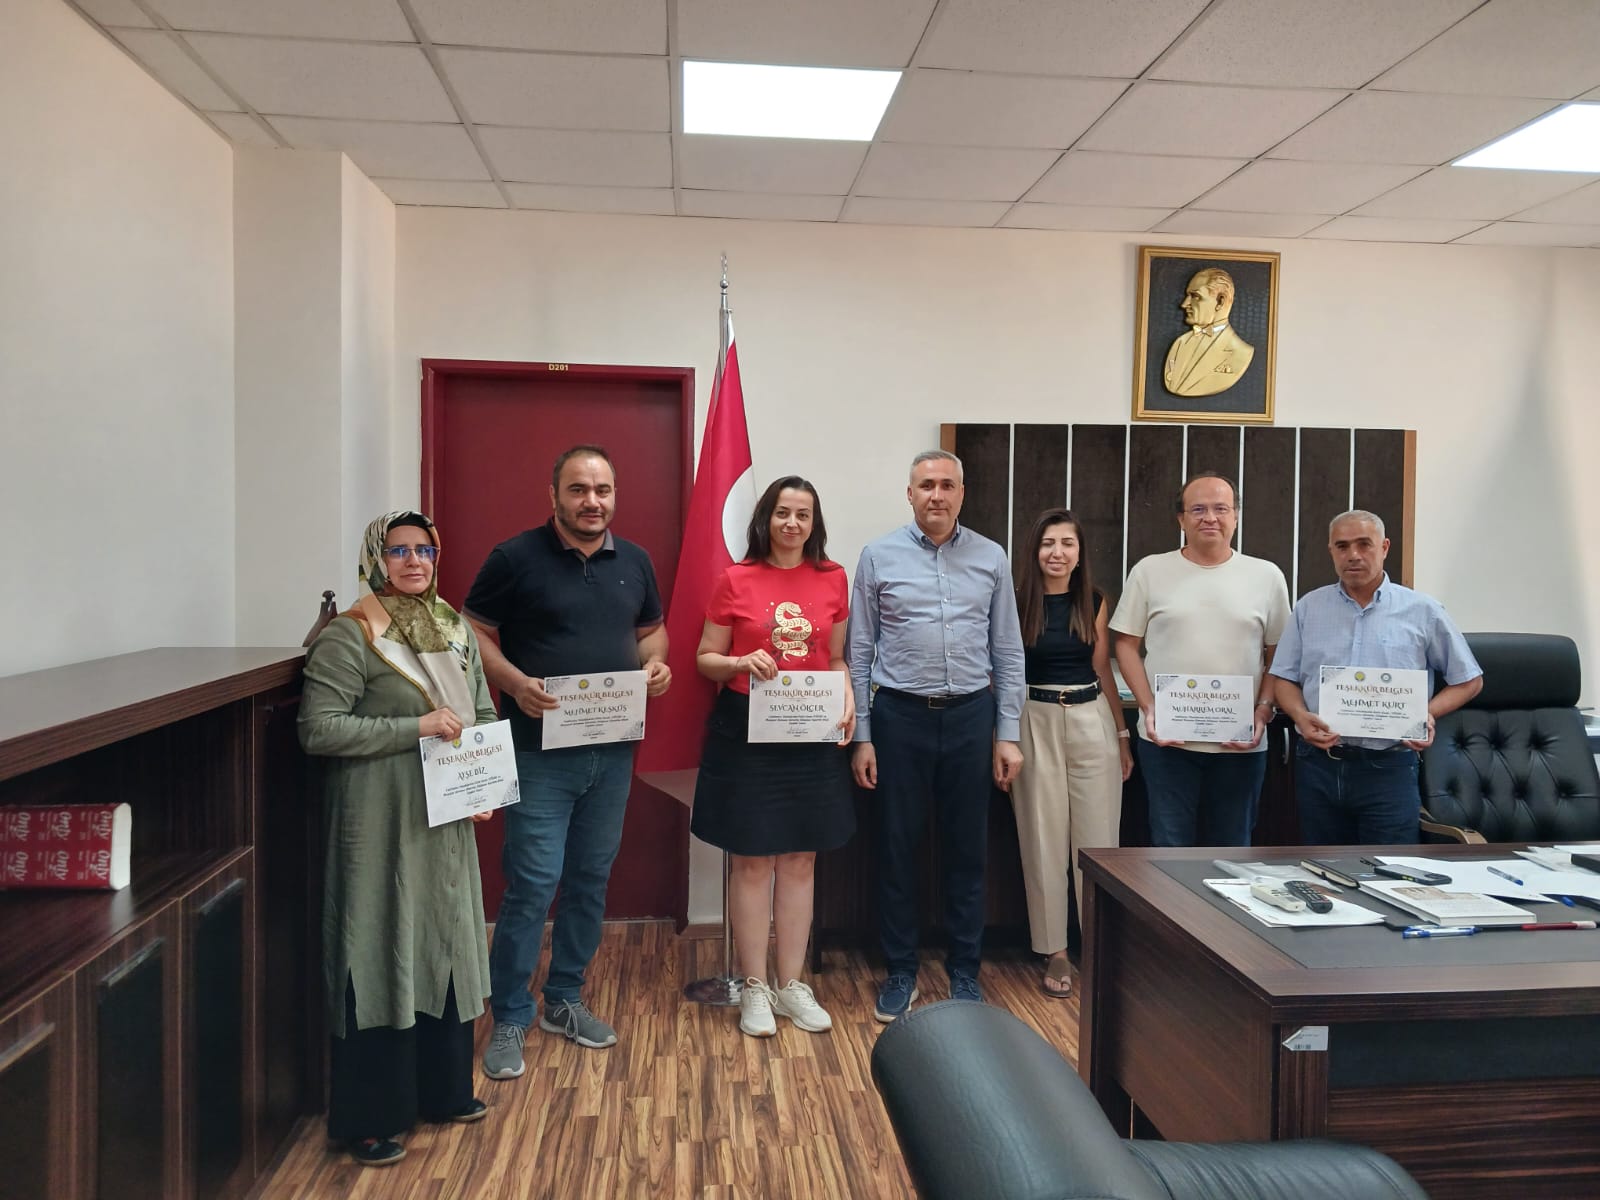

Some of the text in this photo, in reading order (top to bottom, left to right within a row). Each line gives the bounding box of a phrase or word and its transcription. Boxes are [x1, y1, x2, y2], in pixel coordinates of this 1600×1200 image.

[549, 363, 569, 371] D201
[769, 703, 799, 713] SEVCAN
[1382, 701, 1406, 709] KURT
